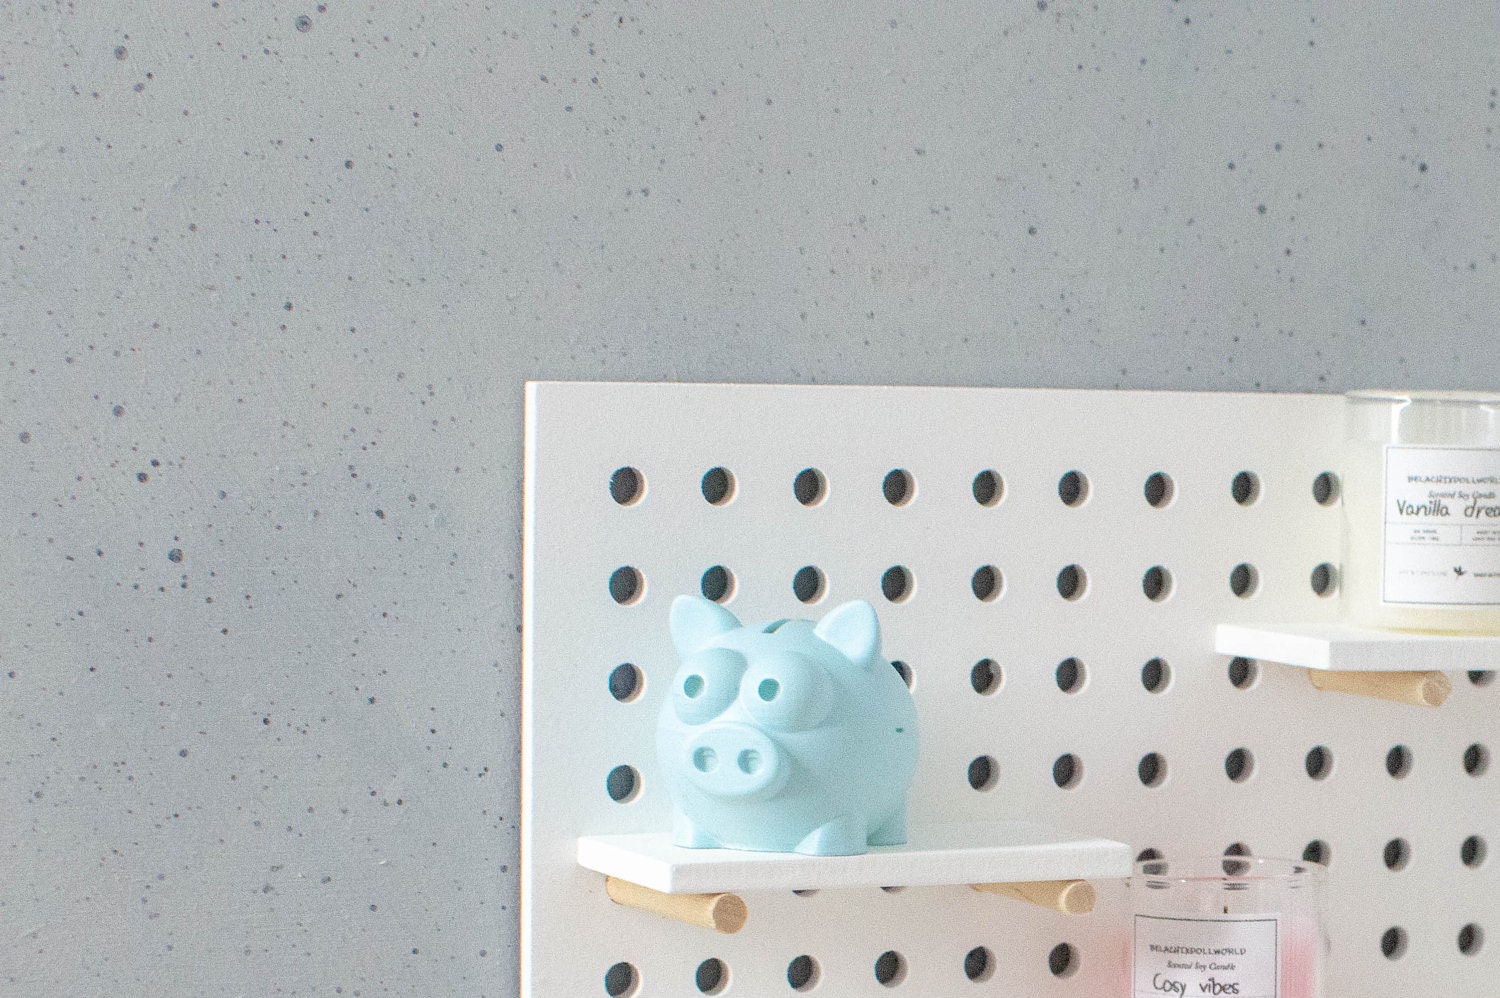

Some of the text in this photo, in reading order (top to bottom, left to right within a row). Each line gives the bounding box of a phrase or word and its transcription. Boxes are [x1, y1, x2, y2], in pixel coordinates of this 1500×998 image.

[1396, 498, 1451, 517] Vanilla
[1153, 973, 1239, 998] Cosy vibes
